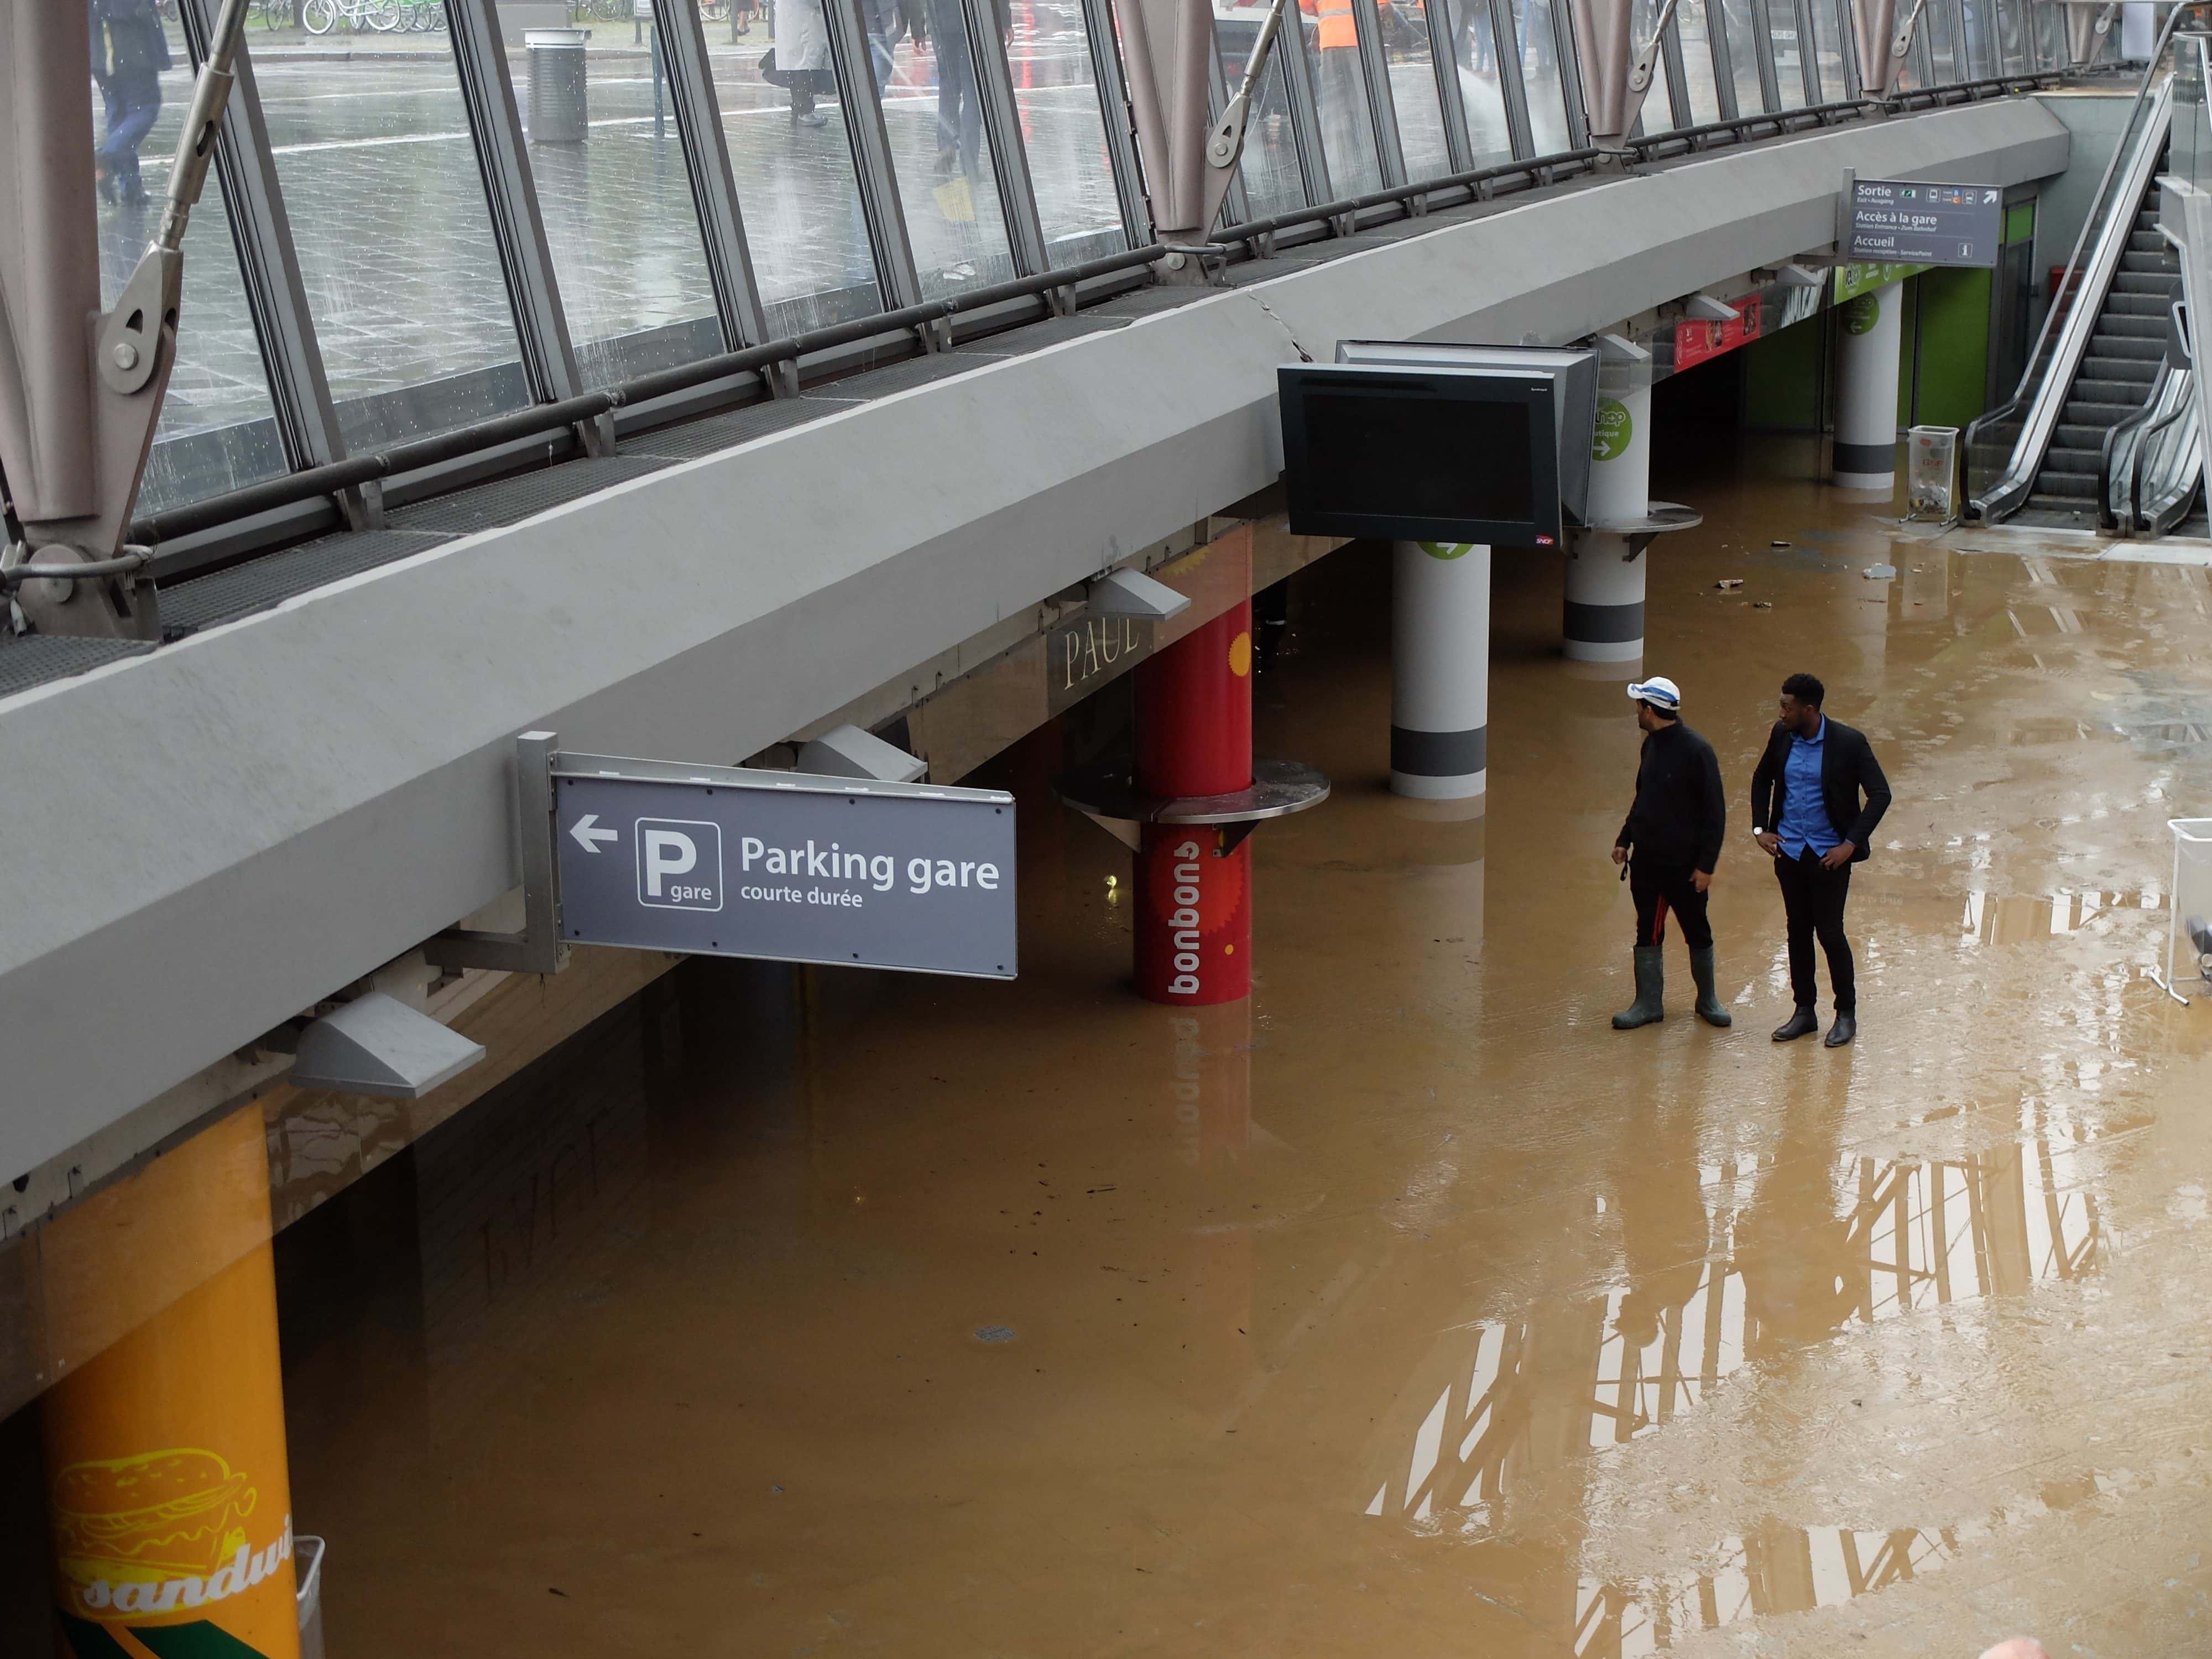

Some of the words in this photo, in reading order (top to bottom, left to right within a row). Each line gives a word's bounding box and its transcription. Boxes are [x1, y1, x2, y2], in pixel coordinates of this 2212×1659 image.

[1858, 185, 1891, 196] Sortie
[1856, 211, 1887, 222] Accès
[1890, 212, 1896, 222] à
[1899, 212, 1909, 223] la
[1911, 215, 1938, 226] gare
[1854, 236, 1895, 247] Accueil
[1065, 617, 1140, 690] PAUL
[645, 830, 697, 897] P
[741, 837, 895, 892] Parking
[907, 858, 1000, 895] gare
[670, 886, 712, 904] gare
[740, 886, 803, 904] courte
[807, 886, 864, 908] durée
[1167, 840, 1200, 994] bonbons
